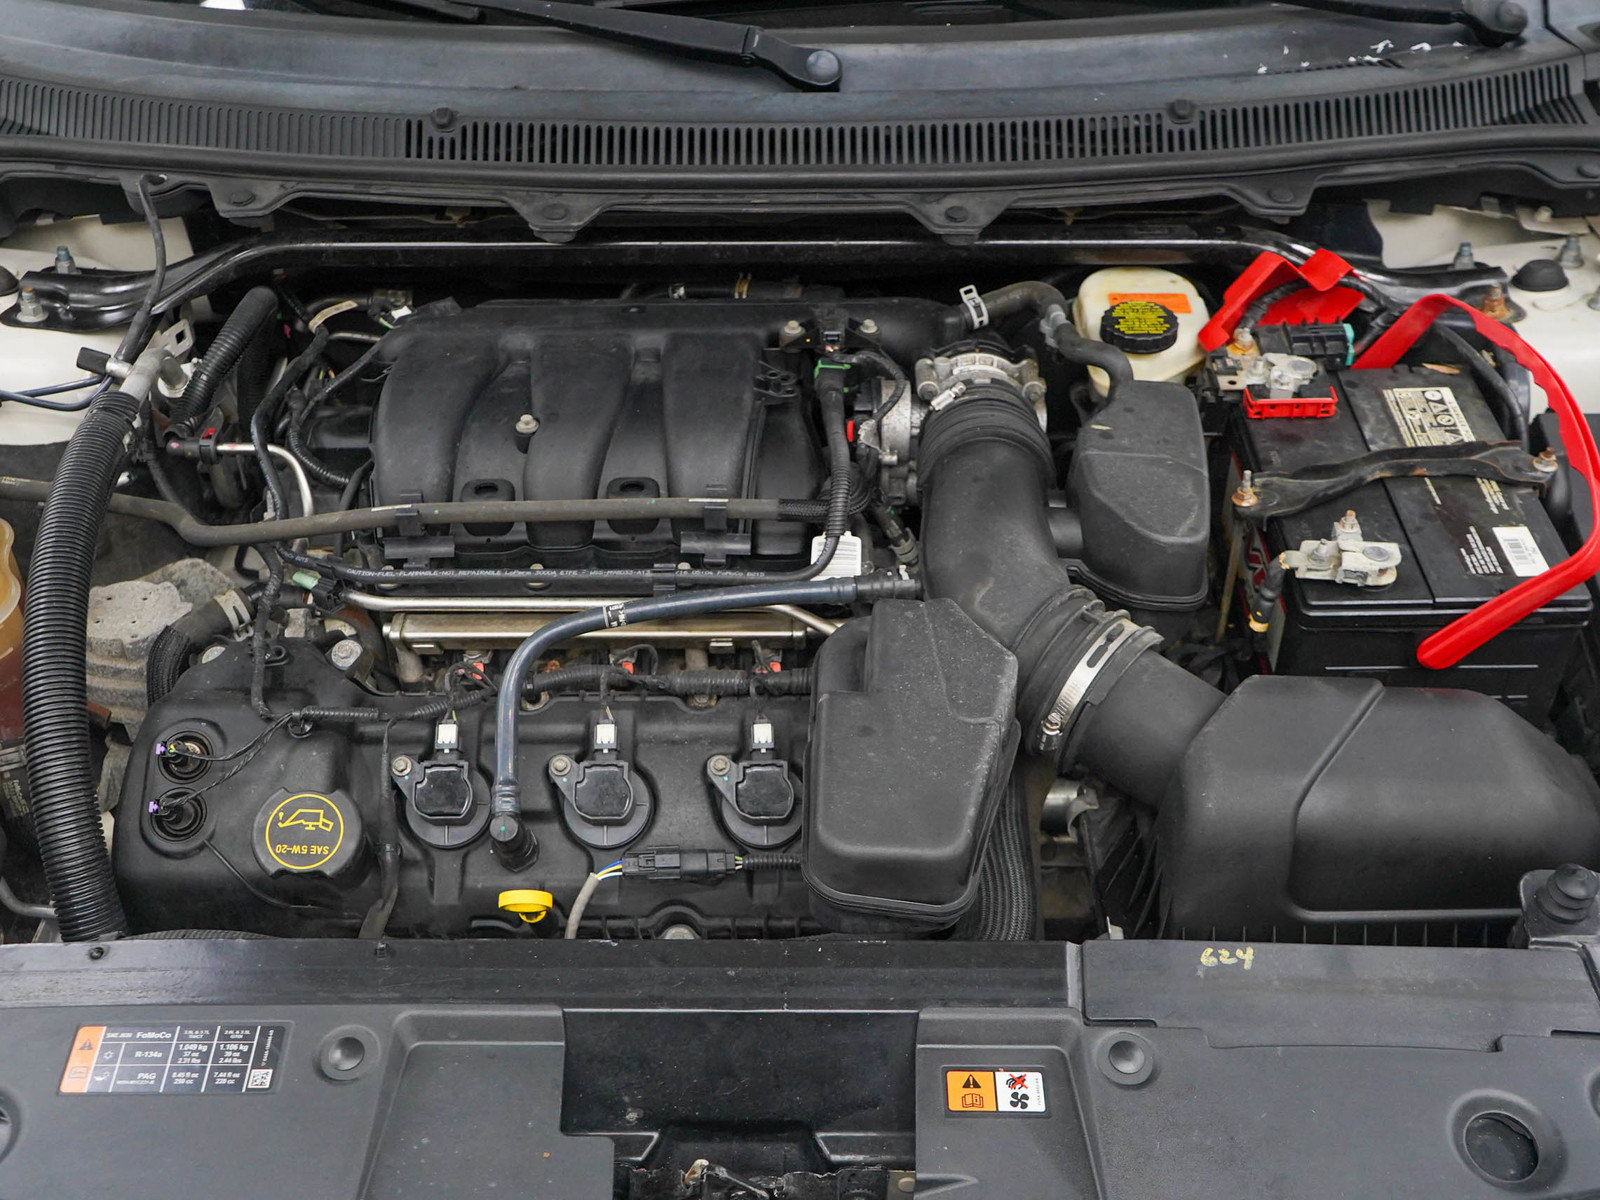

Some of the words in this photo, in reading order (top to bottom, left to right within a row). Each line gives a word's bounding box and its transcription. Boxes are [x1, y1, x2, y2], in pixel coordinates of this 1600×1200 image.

[275, 844, 308, 855] 5W-20
[310, 845, 330, 855] SAE
[1200, 946, 1255, 970] 624
[135, 1031, 172, 1039] FoMoCo
[198, 1044, 208, 1052] kg
[239, 1044, 249, 1052] kg
[136, 1072, 157, 1080] PAG
